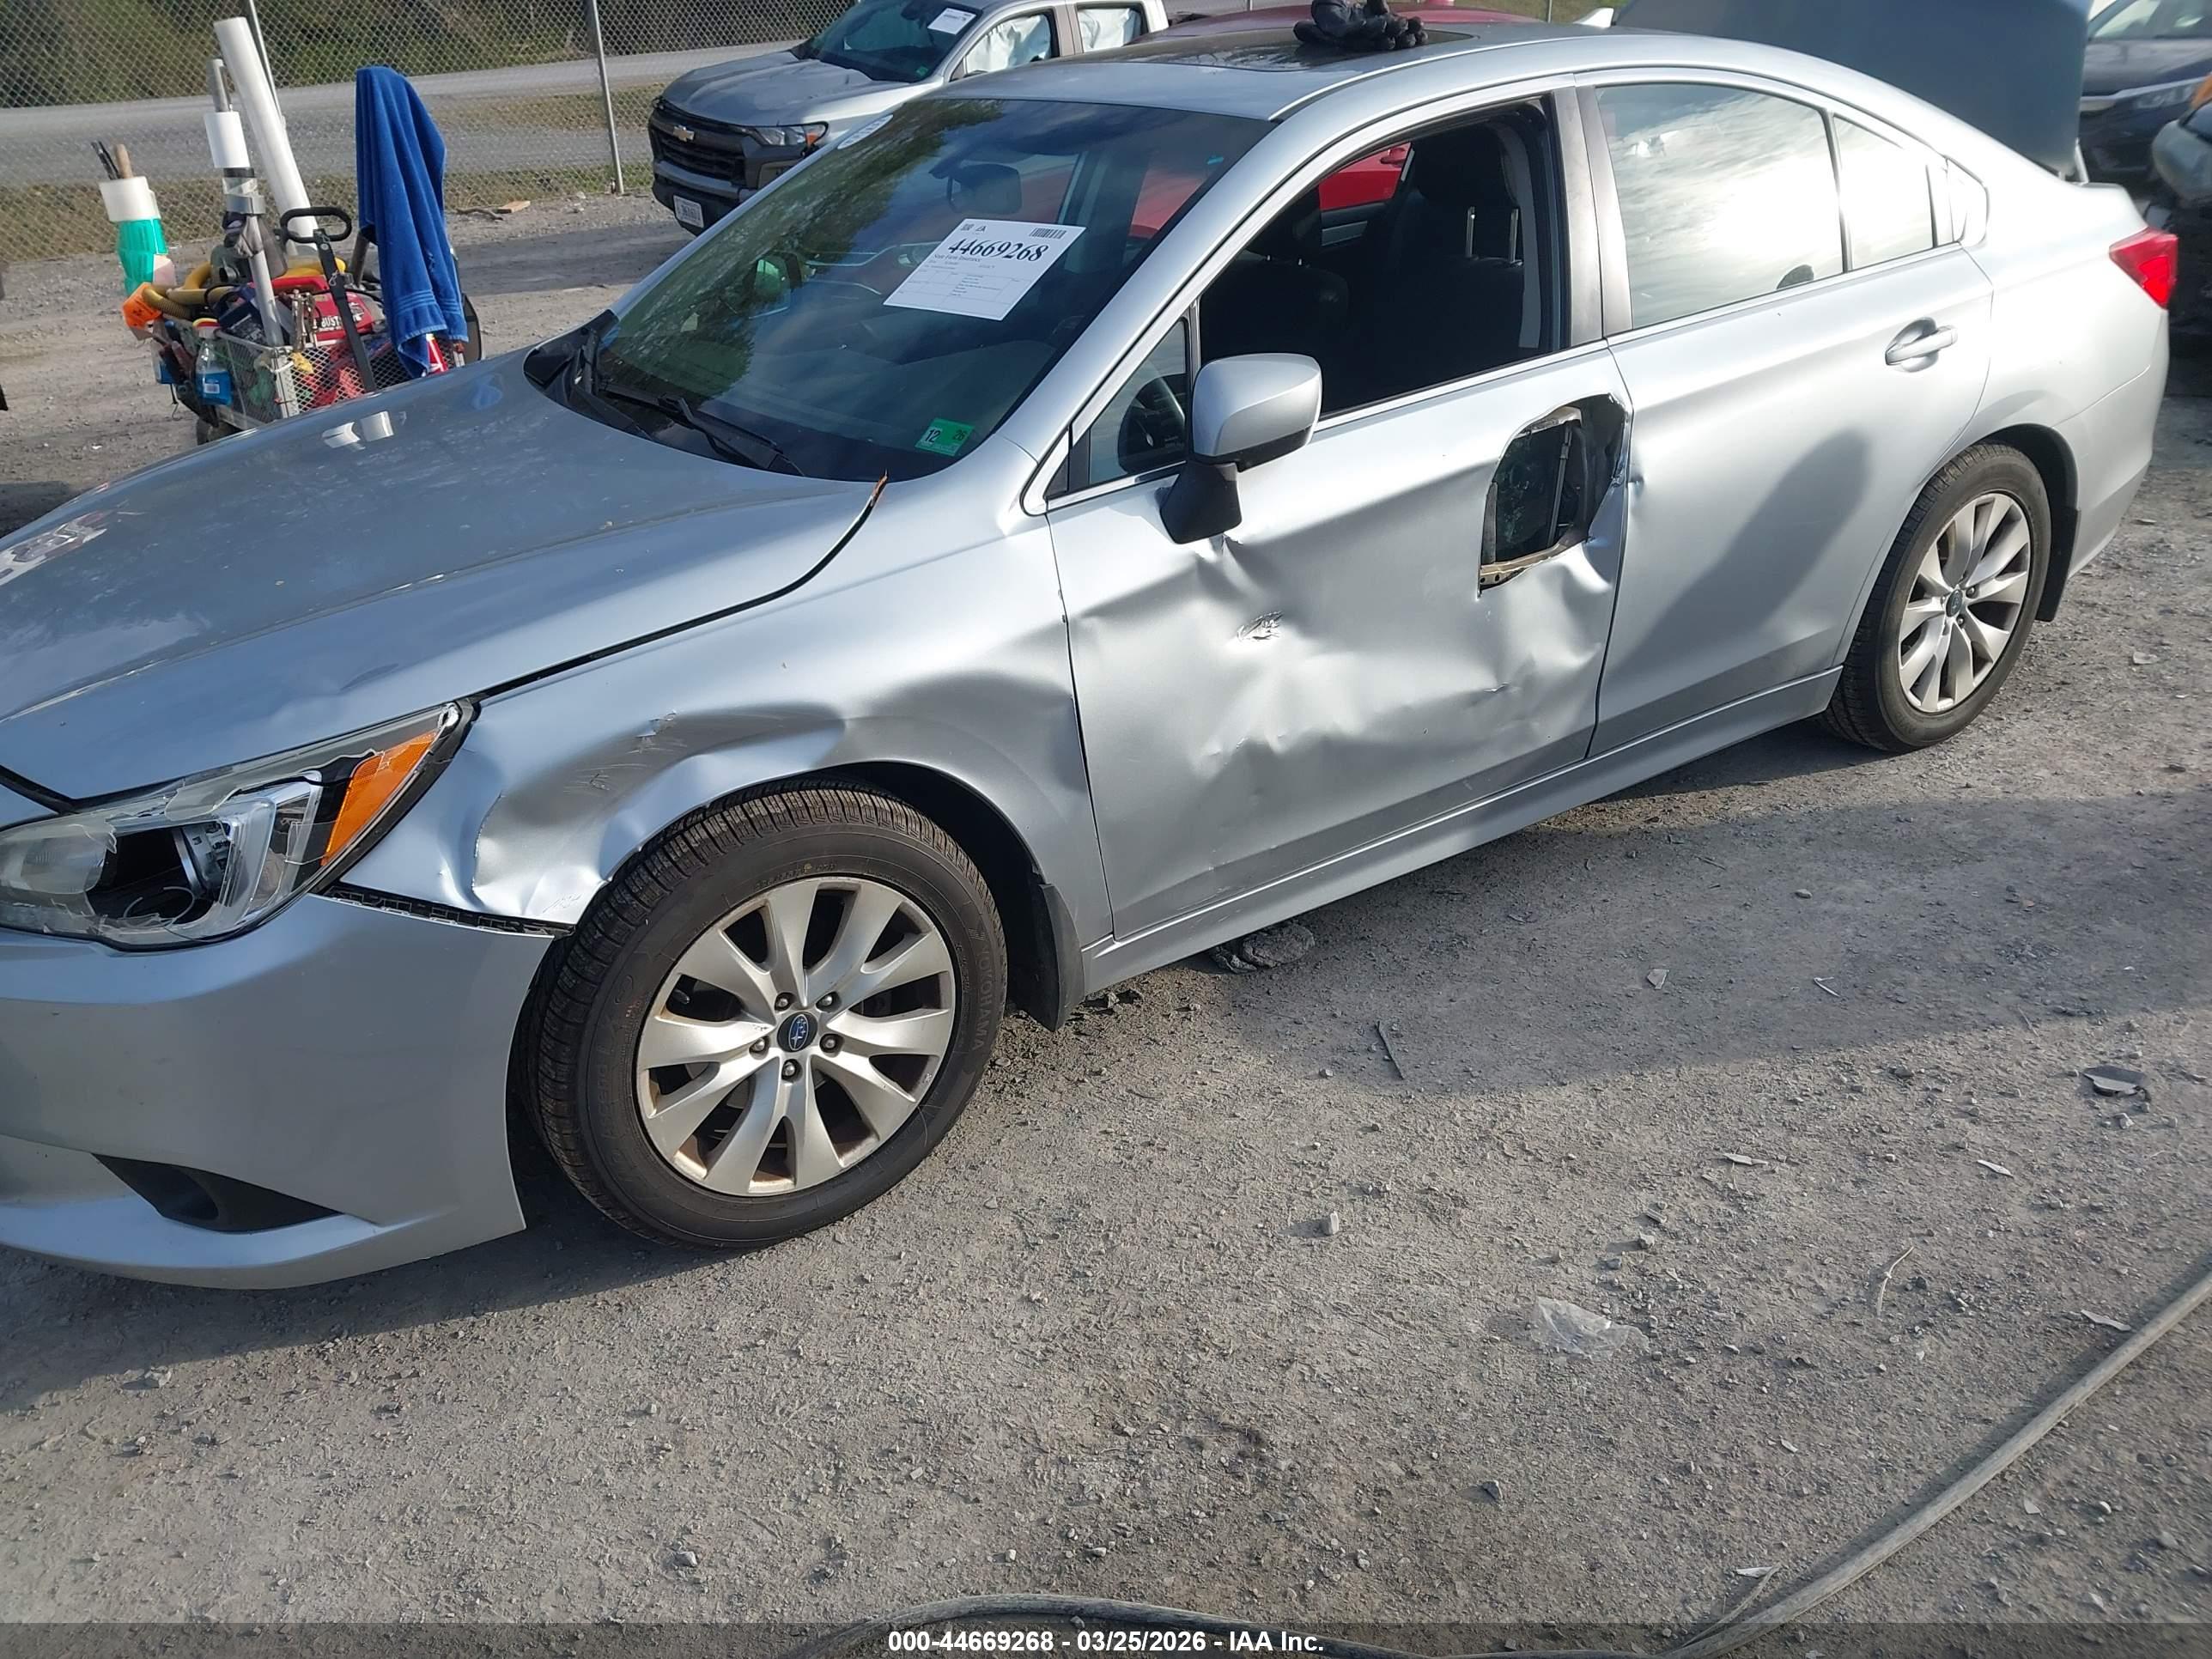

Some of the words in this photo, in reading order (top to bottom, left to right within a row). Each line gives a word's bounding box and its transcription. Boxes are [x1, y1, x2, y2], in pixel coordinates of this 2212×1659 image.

[948, 239, 1049, 262] 44669268
[924, 428, 942, 443] 12
[971, 946, 993, 1051] YOKOHAMA
